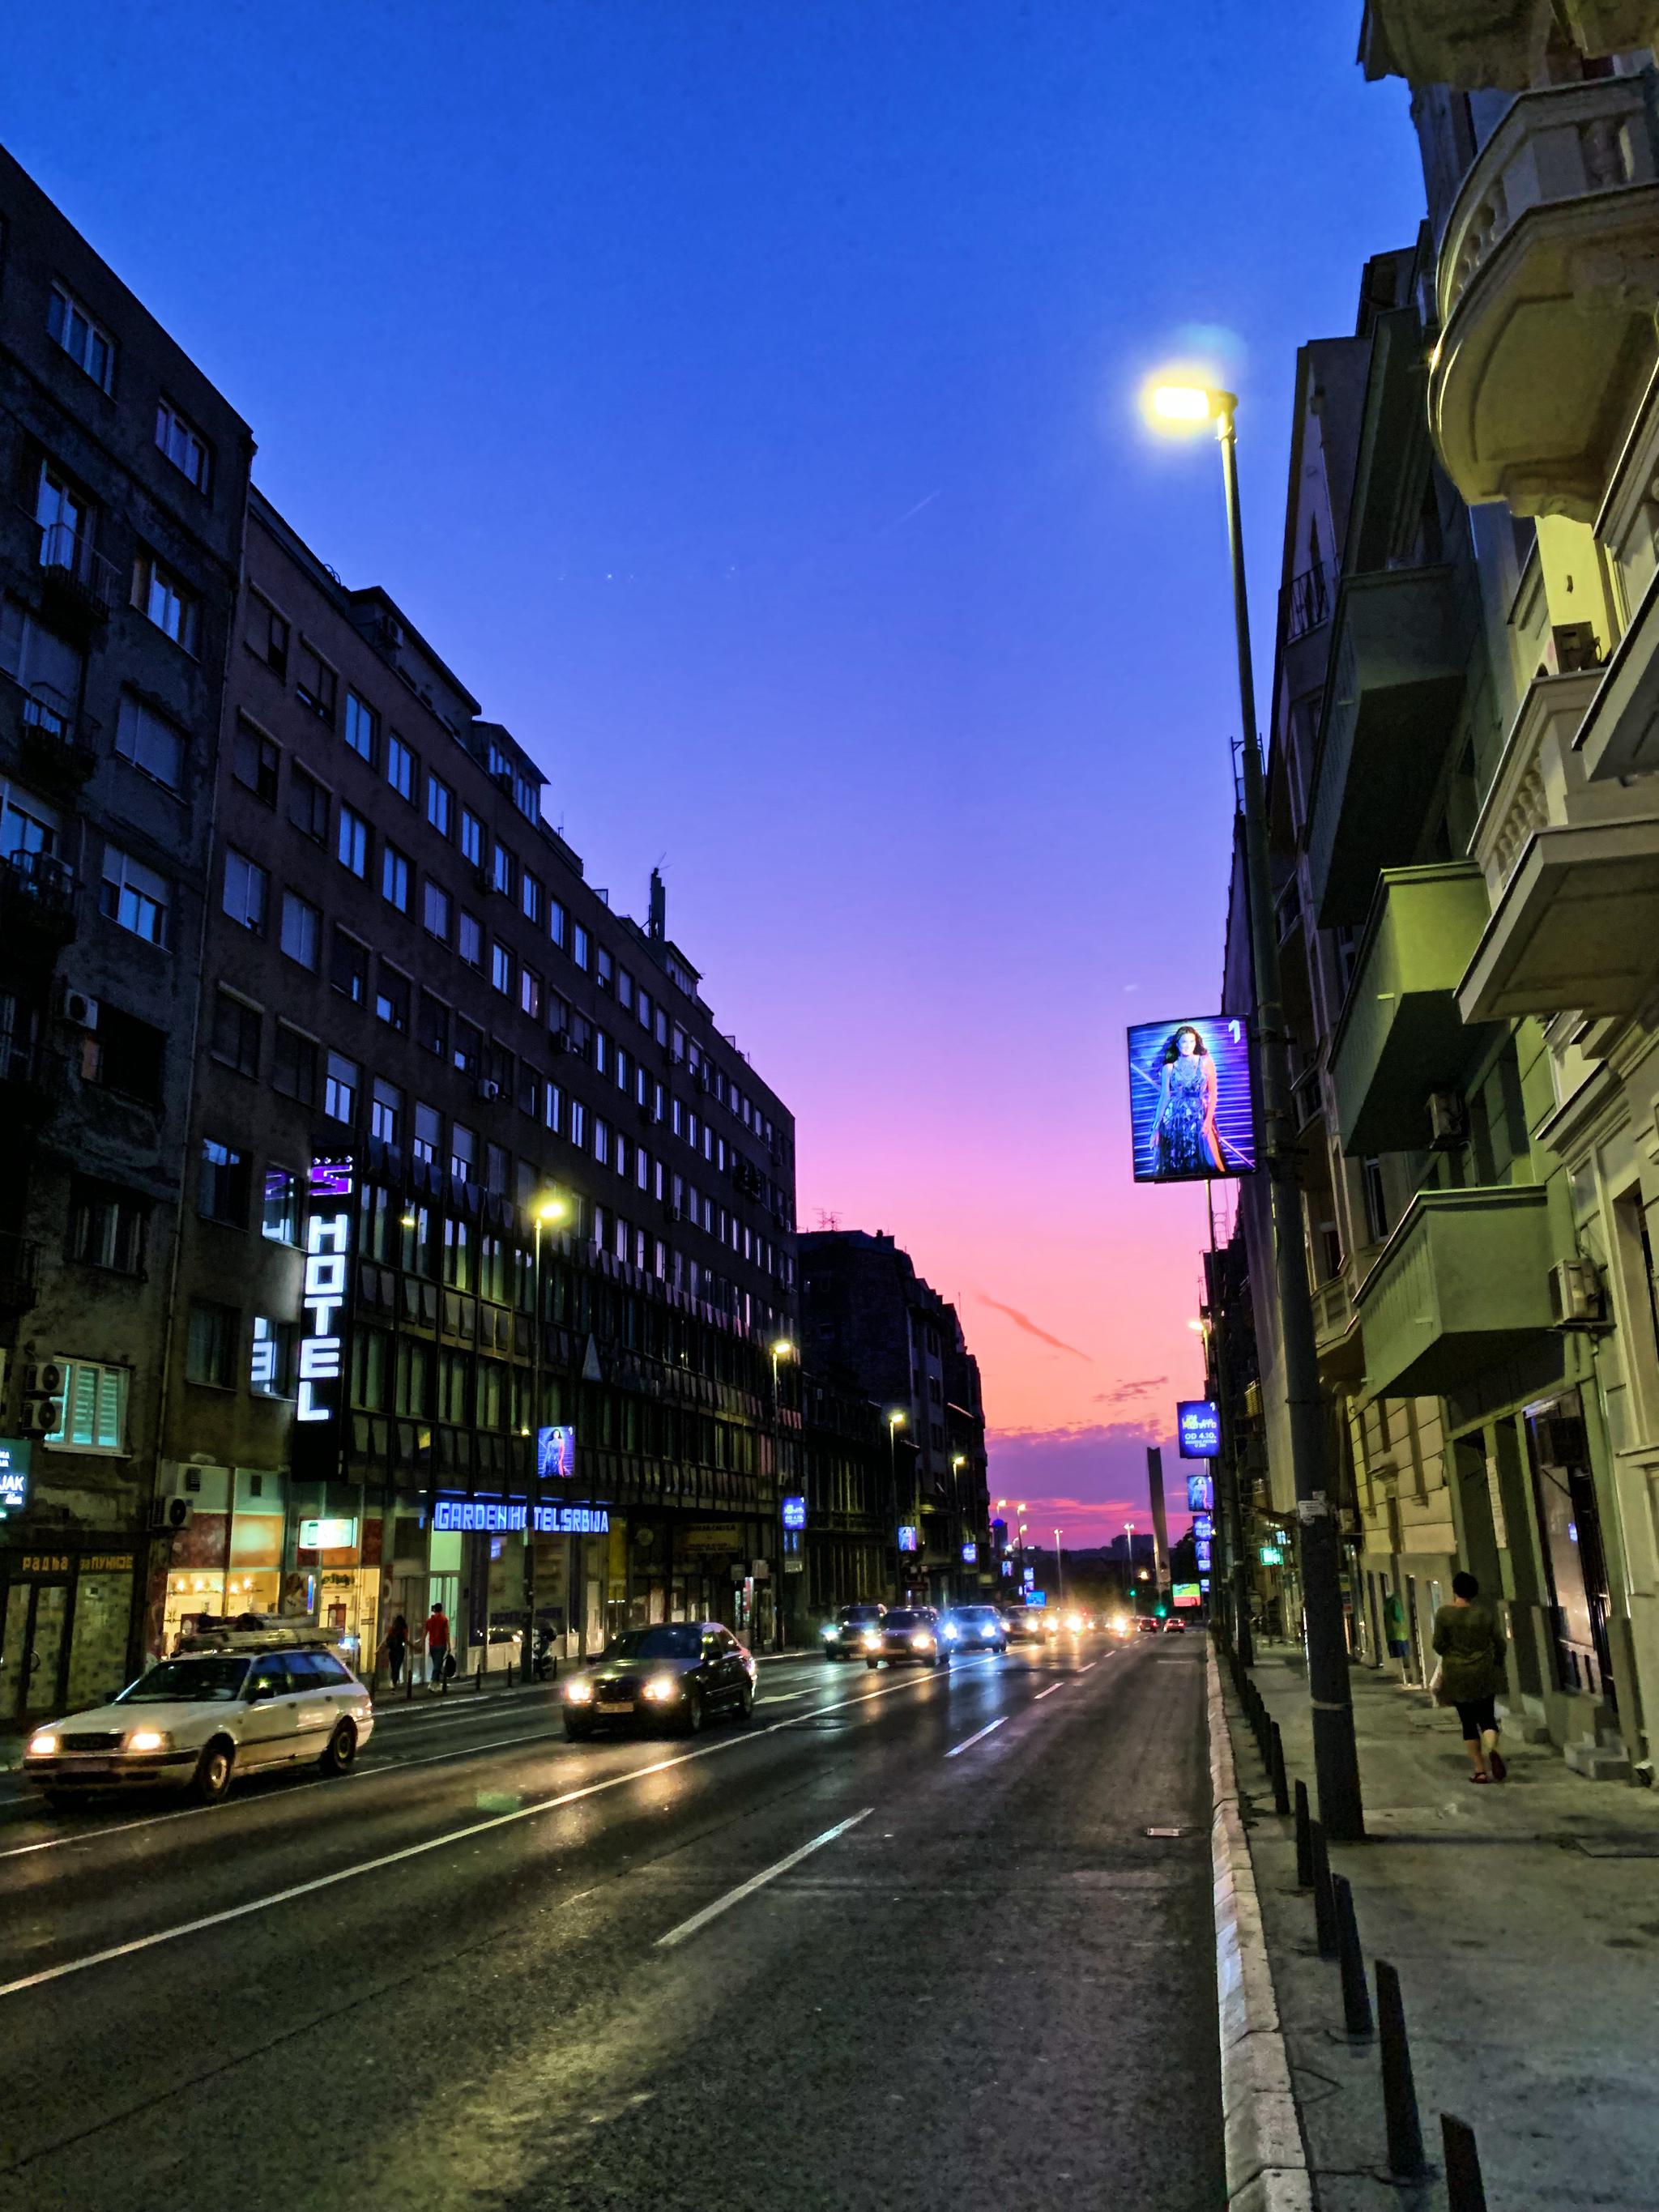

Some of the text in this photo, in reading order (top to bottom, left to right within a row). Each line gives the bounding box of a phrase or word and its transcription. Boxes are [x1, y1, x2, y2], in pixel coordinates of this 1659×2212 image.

[297, 1214, 348, 1421] HOTEL
[438, 1502, 507, 1530] GARDEN
[561, 1508, 609, 1532] SRBIJA
